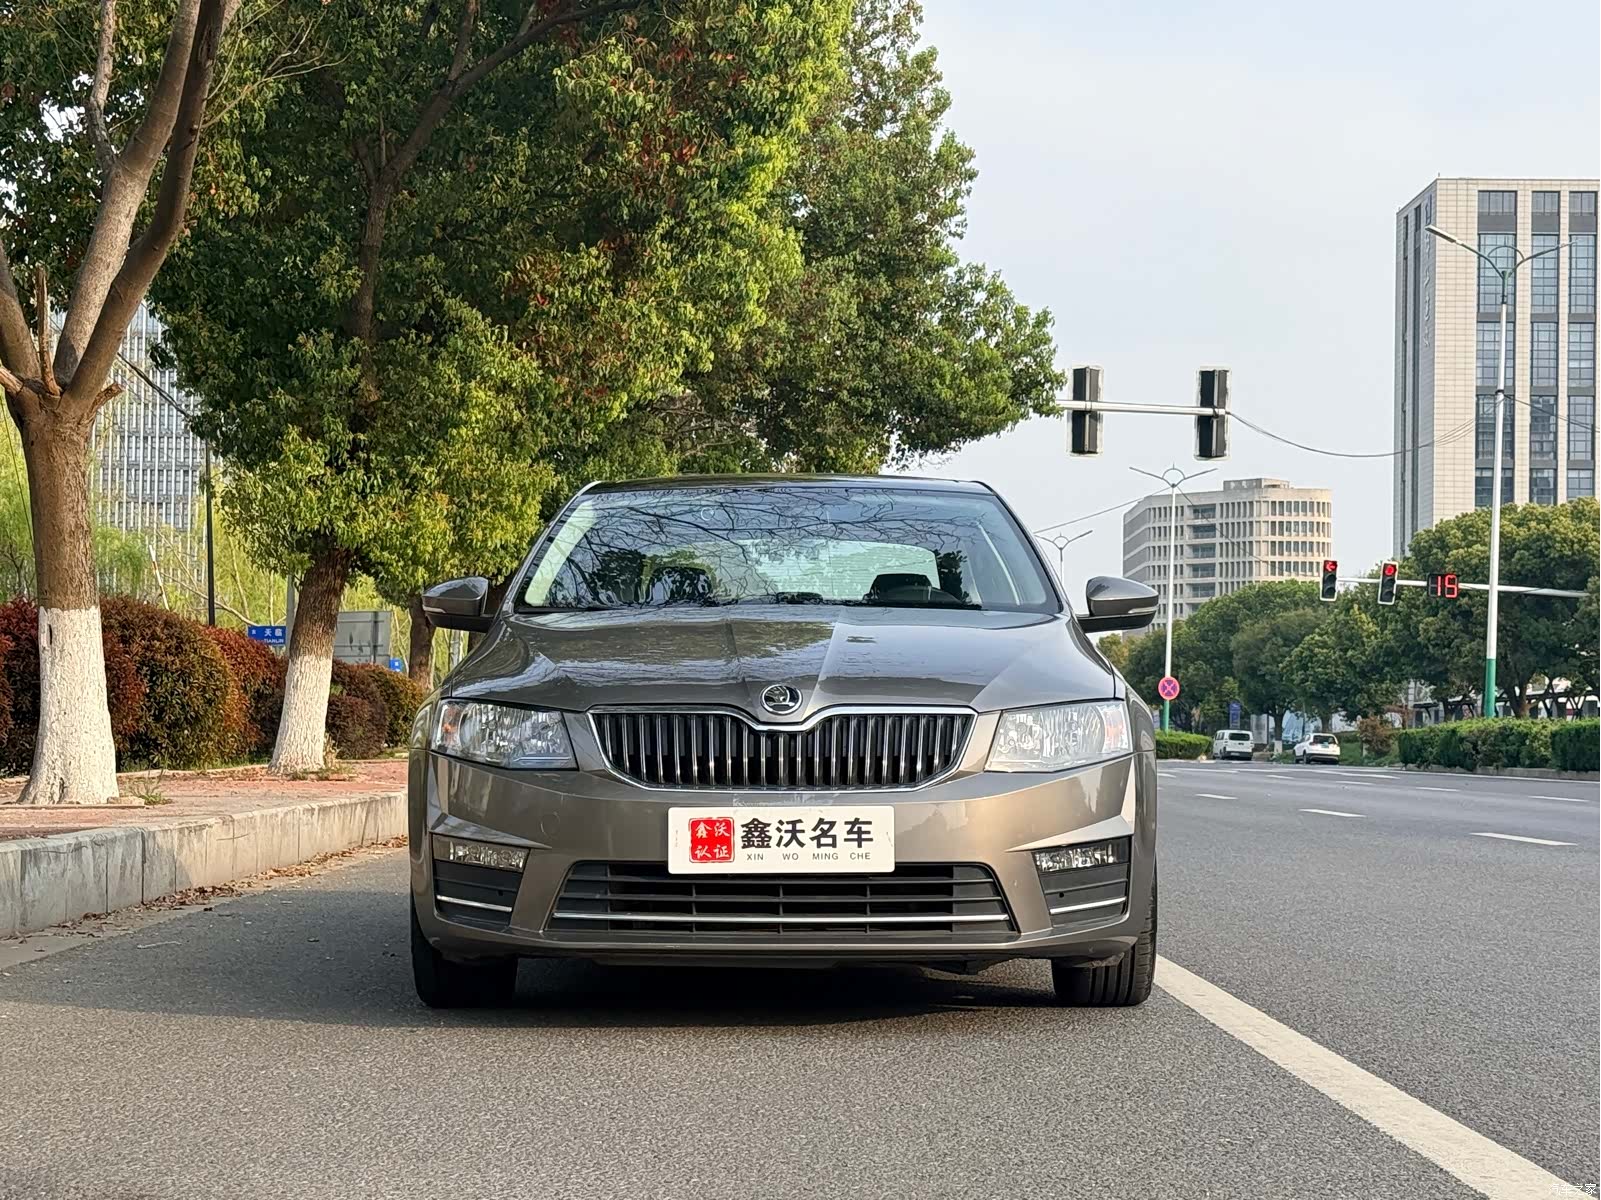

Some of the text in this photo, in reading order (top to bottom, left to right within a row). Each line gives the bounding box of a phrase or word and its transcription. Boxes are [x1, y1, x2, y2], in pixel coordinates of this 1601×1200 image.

[1437, 575, 1457, 598] 15
[695, 821, 730, 839] 鑫沃
[740, 817, 874, 850] 鑫沃名车
[694, 844, 730, 859] 认证
[747, 852, 871, 861] XIN WO MING CHE
